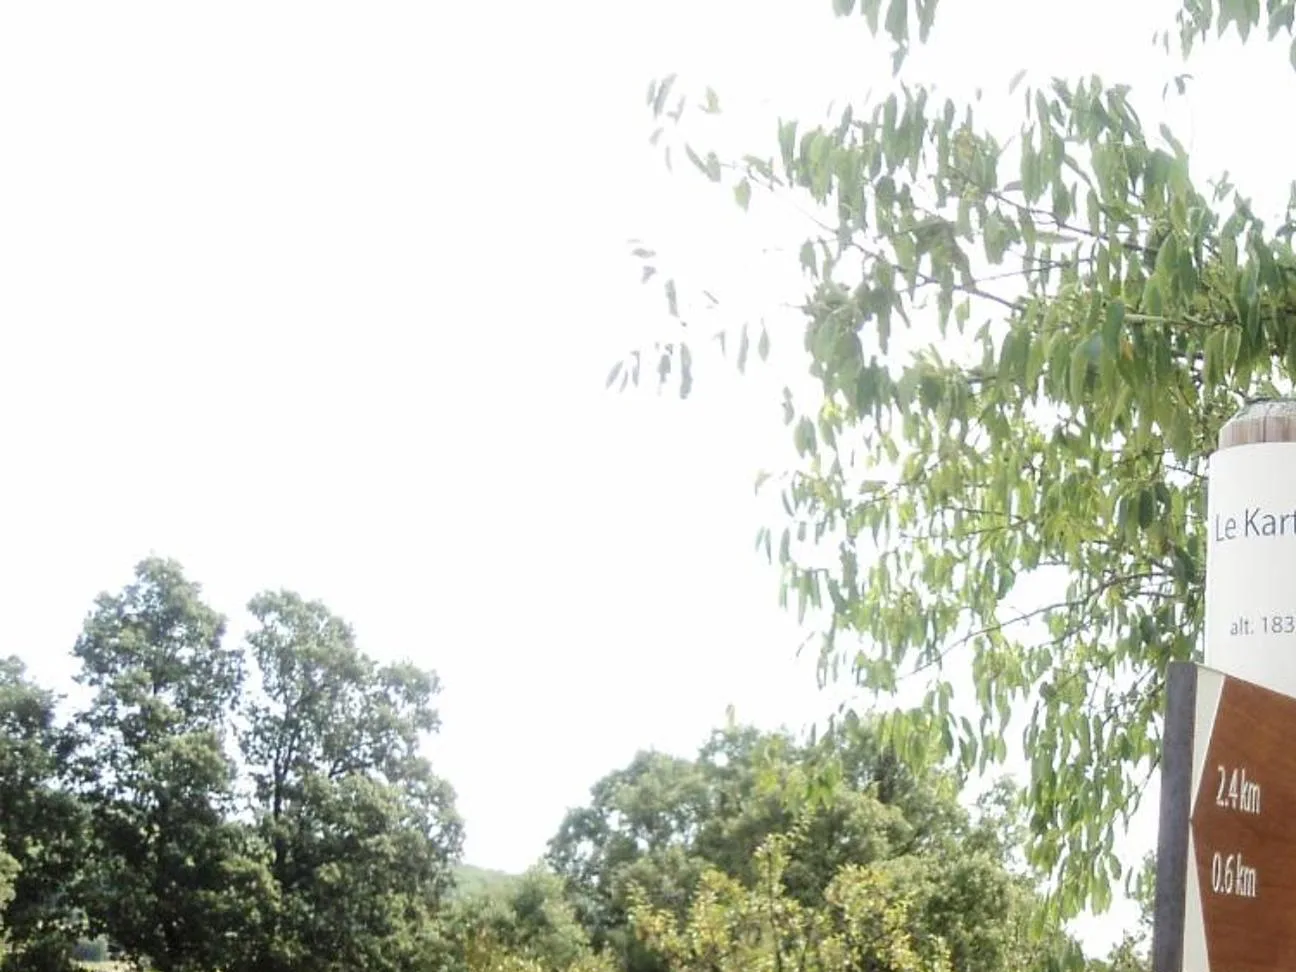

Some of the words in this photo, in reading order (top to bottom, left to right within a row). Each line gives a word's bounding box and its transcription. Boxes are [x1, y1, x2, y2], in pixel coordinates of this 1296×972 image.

[1215, 513, 1237, 542] Le
[1230, 616, 1255, 636] alt.
[1262, 616, 1295, 633] 183
[1216, 765, 1238, 809] 2.4
[1240, 768, 1260, 814] km
[1212, 851, 1234, 893] 0.6
[1235, 852, 1256, 897] km
